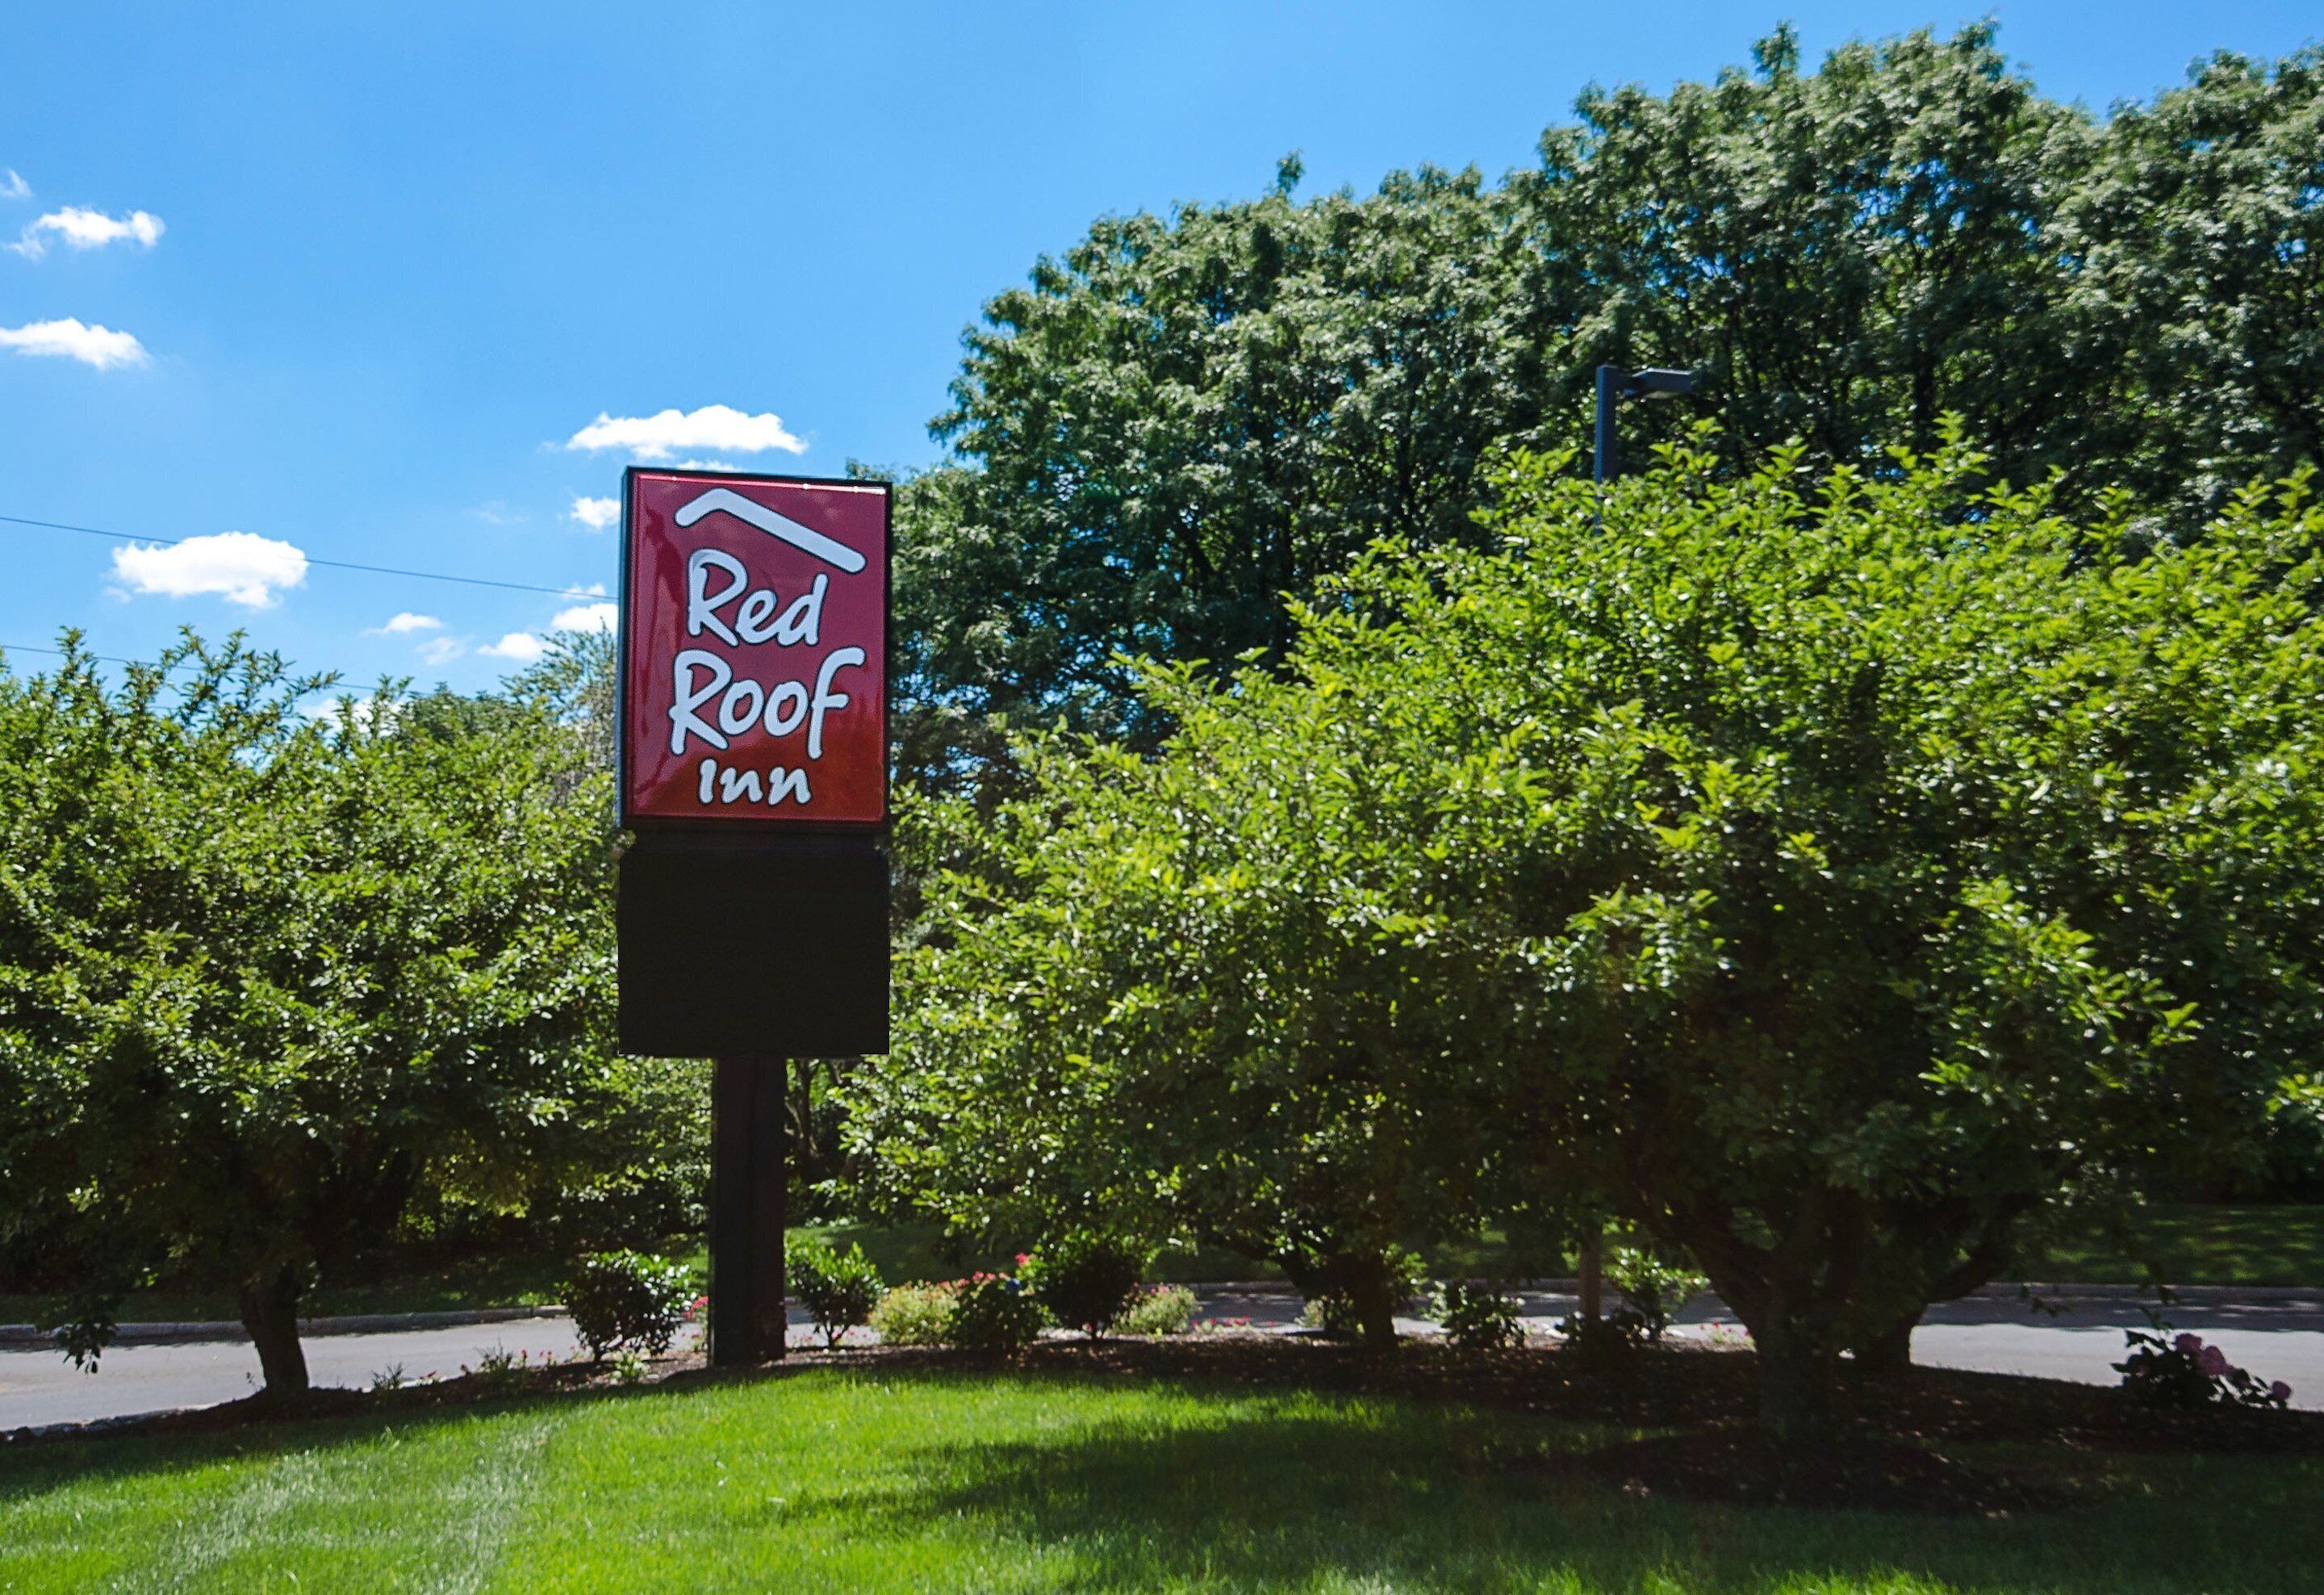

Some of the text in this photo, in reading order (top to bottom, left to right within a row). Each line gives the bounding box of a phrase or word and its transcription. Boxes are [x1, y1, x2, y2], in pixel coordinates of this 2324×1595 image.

[688, 548, 829, 646] Red
[669, 647, 866, 759] Roof
[700, 759, 812, 806] Inn
